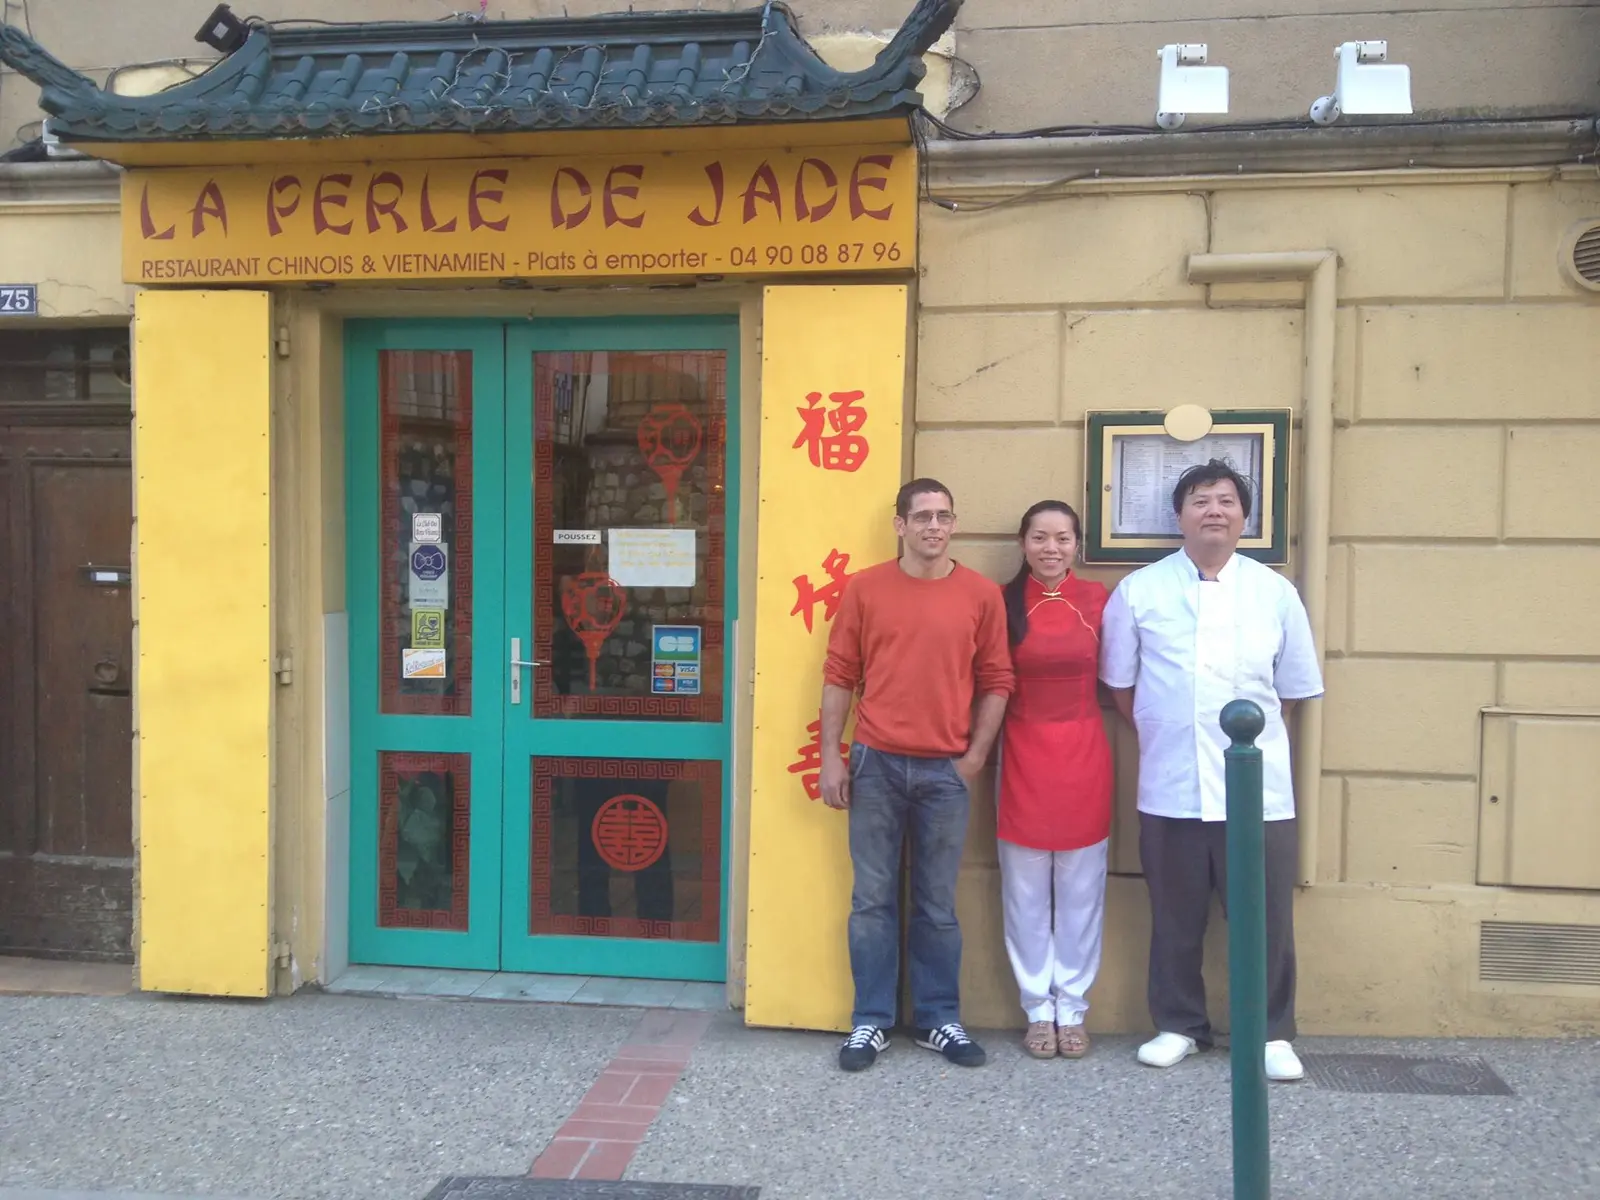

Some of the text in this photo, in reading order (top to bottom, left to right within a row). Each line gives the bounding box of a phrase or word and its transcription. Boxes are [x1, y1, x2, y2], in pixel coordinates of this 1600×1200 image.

[140, 154, 894, 240] LA PERLE DE JADE
[142, 257, 261, 278] RESTAURANT
[267, 256, 354, 276] CHINOIS
[361, 255, 377, 274] &
[382, 252, 505, 273] VIETNAMIEN
[528, 251, 576, 271] Plats
[583, 249, 598, 270] à
[605, 249, 708, 275] emporter
[730, 246, 757, 267] 04
[766, 245, 793, 266] 90
[801, 244, 828, 265] 08
[837, 243, 864, 264] 87
[873, 242, 901, 263] 96
[1, 289, 29, 310] 75
[558, 533, 597, 541] POUSSEZ
